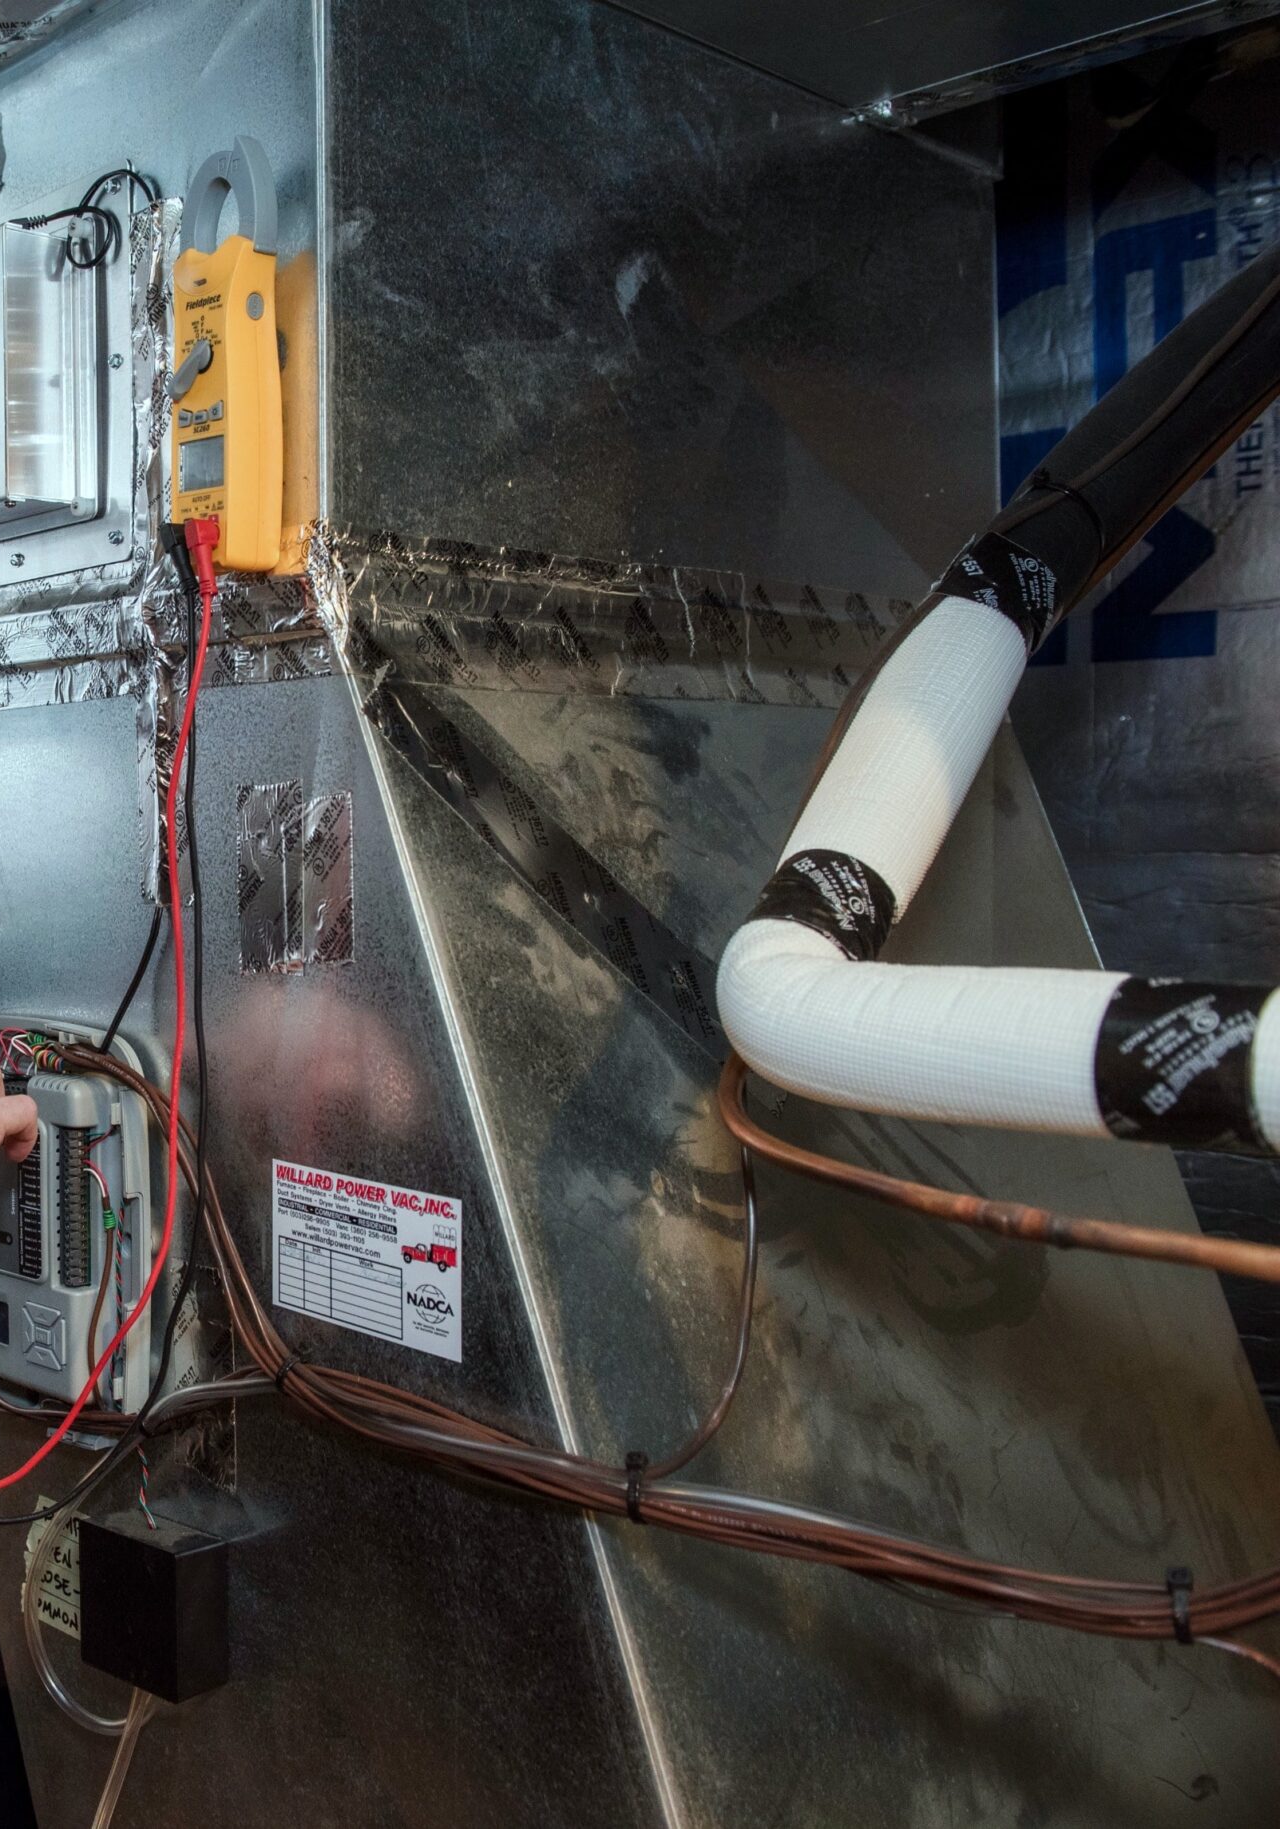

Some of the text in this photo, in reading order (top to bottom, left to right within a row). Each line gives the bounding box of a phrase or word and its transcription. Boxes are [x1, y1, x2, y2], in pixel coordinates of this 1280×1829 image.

[185, 294, 222, 311] Fieldpiece
[276, 1164, 334, 1192] WILLARD
[336, 1179, 388, 1205] POWER
[277, 1180, 297, 1190] Furnace
[303, 1186, 327, 1198] Fireplace
[357, 1200, 381, 1211] Chimney
[277, 1188, 289, 1197] Duct
[291, 1192, 313, 1203] Systems
[319, 1199, 334, 1208] Dryer
[335, 1203, 351, 1212] Vents
[378, 1213, 397, 1223] Filters
[278, 1199, 396, 1233] INDUSTRIAL COMMERCIAL RESIDENTIAL
[305, 1223, 321, 1233] Salem
[434, 1231, 456, 1241] WILLARD
[291, 1229, 381, 1259] www.willardpowervac.com
[358, 1259, 375, 1268] Work
[407, 1291, 455, 1318] NADCA
